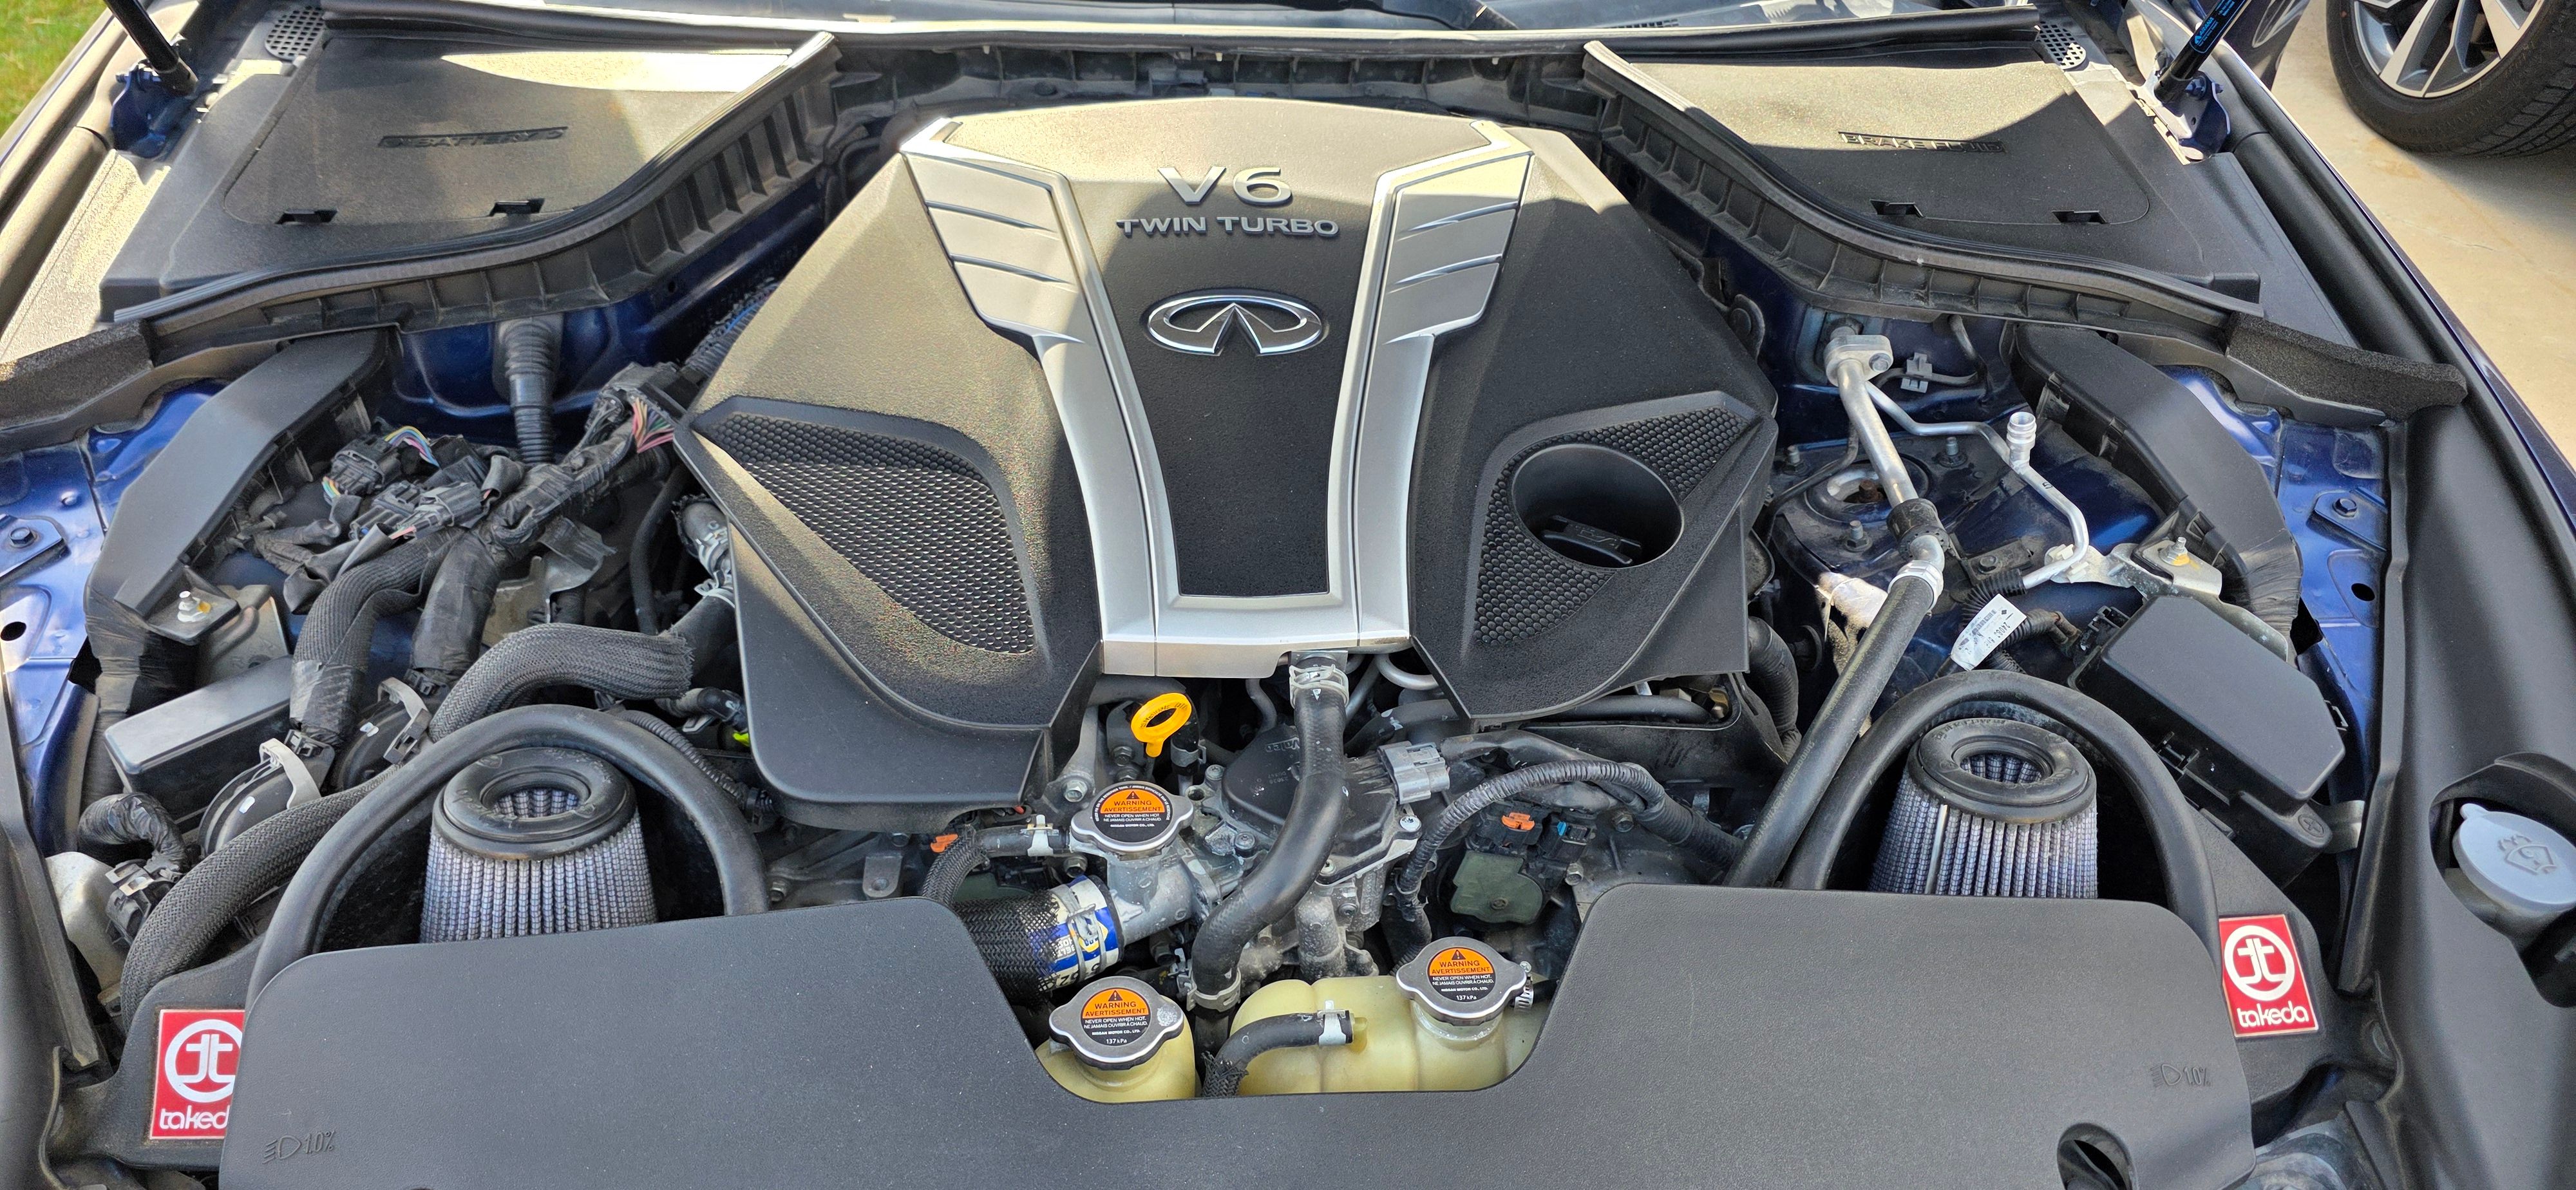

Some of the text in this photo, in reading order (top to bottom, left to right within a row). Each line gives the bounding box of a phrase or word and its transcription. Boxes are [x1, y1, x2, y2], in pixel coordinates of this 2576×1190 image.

[1841, 133, 1927, 149] BRAKE
[1157, 165, 1293, 207] V6
[1116, 216, 1340, 238] TWIN TURBO
[1085, 1008, 1146, 1017] AVERTISSEMENT
[1094, 1001, 1137, 1010] WARNING
[2237, 1001, 2309, 1028] takeda
[2183, 1066, 2211, 1087] 1.0%
[160, 1106, 230, 1129] taked
[304, 1129, 336, 1155] 1.0%
